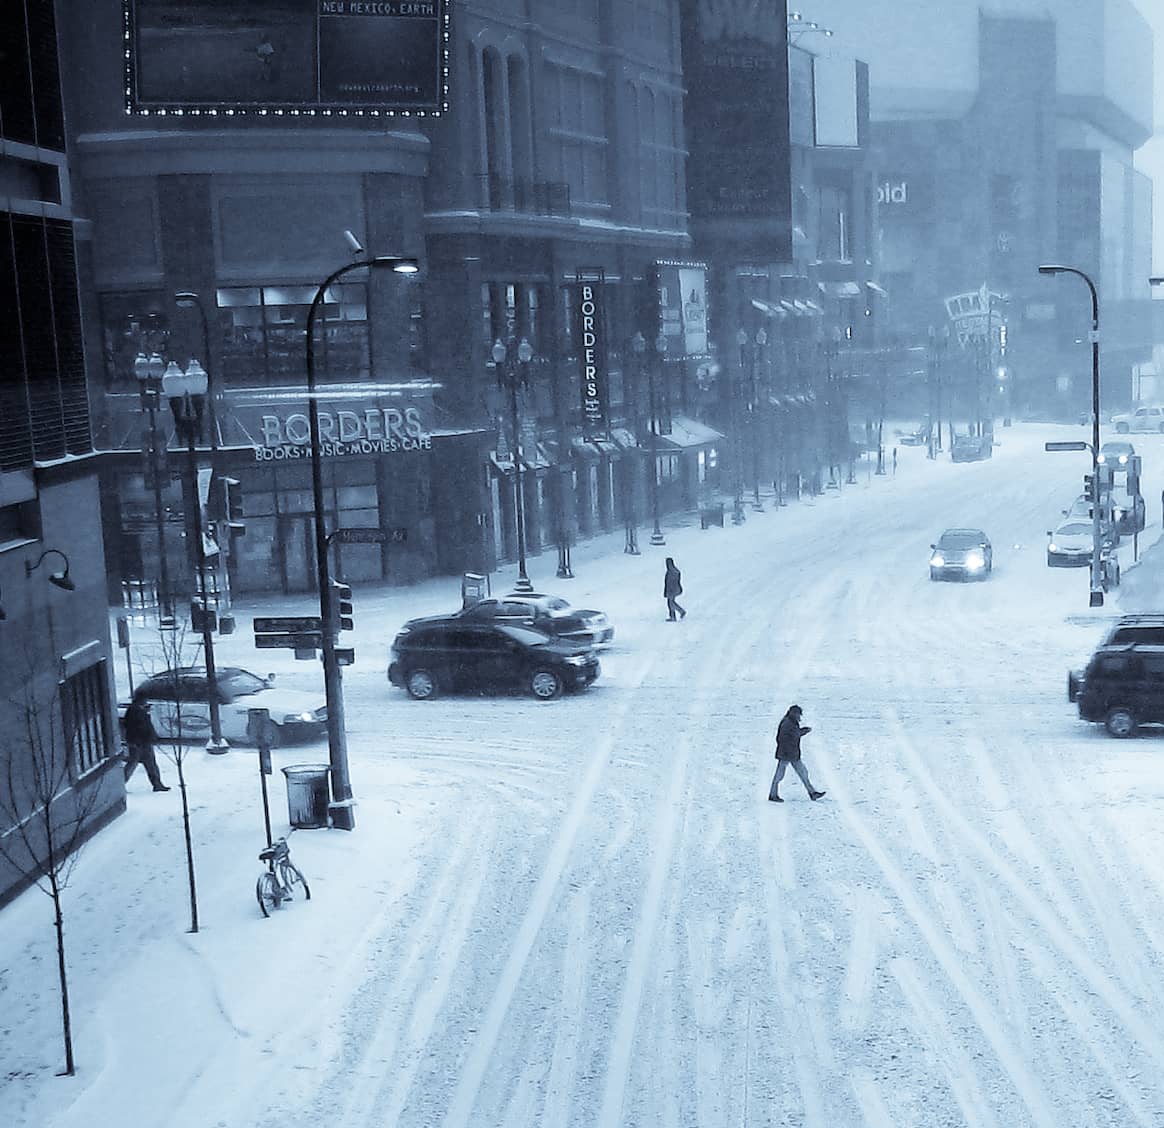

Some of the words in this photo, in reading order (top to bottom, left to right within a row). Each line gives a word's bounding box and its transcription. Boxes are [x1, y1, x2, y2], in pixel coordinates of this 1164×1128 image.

[322, 1, 344, 13] NEW
[399, 3, 434, 15] EARTH
[582, 286, 598, 397] BORDERS
[261, 407, 422, 448] BORDERS
